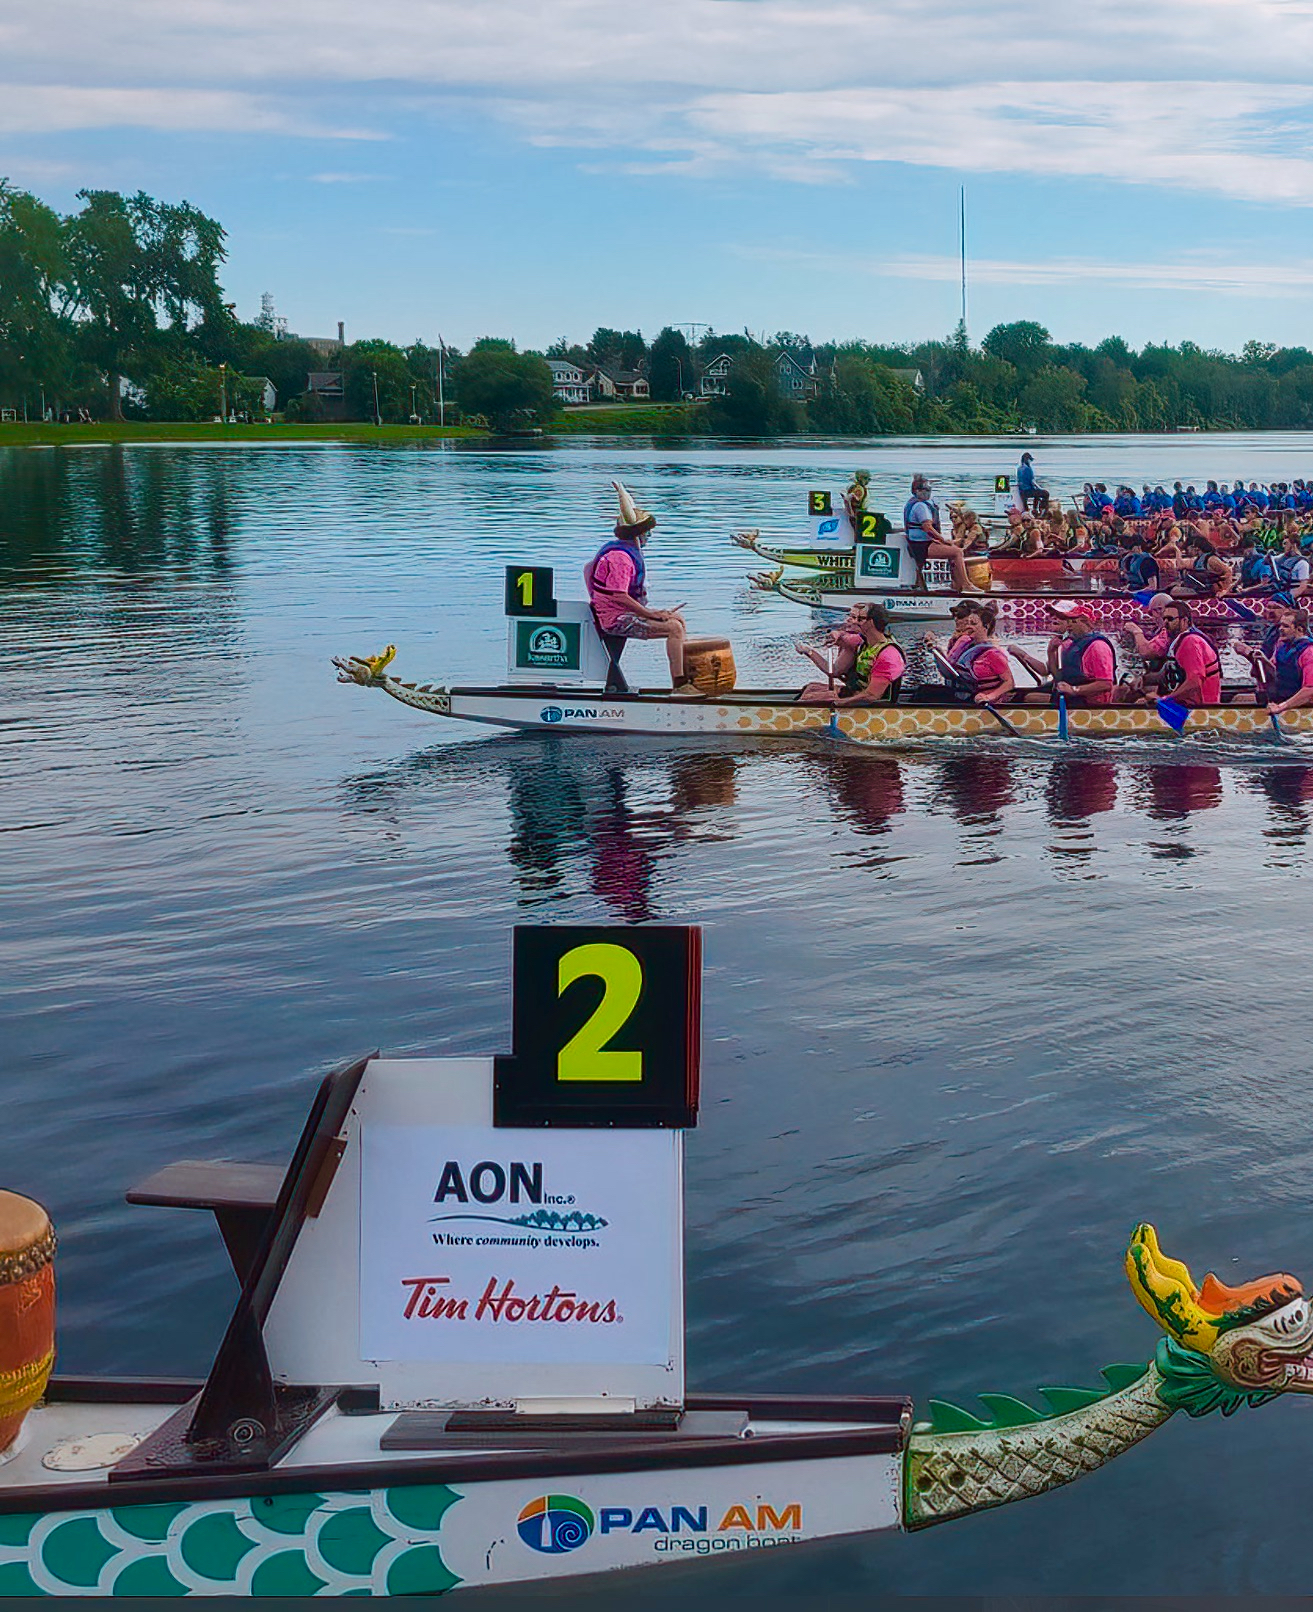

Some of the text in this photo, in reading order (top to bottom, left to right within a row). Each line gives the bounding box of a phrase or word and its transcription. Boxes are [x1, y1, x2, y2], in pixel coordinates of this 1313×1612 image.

[997, 476, 1005, 489] 4
[813, 493, 825, 511] 3
[861, 515, 877, 538] 2
[517, 571, 533, 606] 1
[564, 708, 625, 718] PAN AM
[556, 942, 644, 1082] 2
[433, 1160, 543, 1204] AON
[432, 1233, 600, 1249] Where community develops.
[401, 1277, 469, 1321] Tim
[600, 1503, 802, 1534] PAN AM
[654, 1536, 740, 1555] dragon
